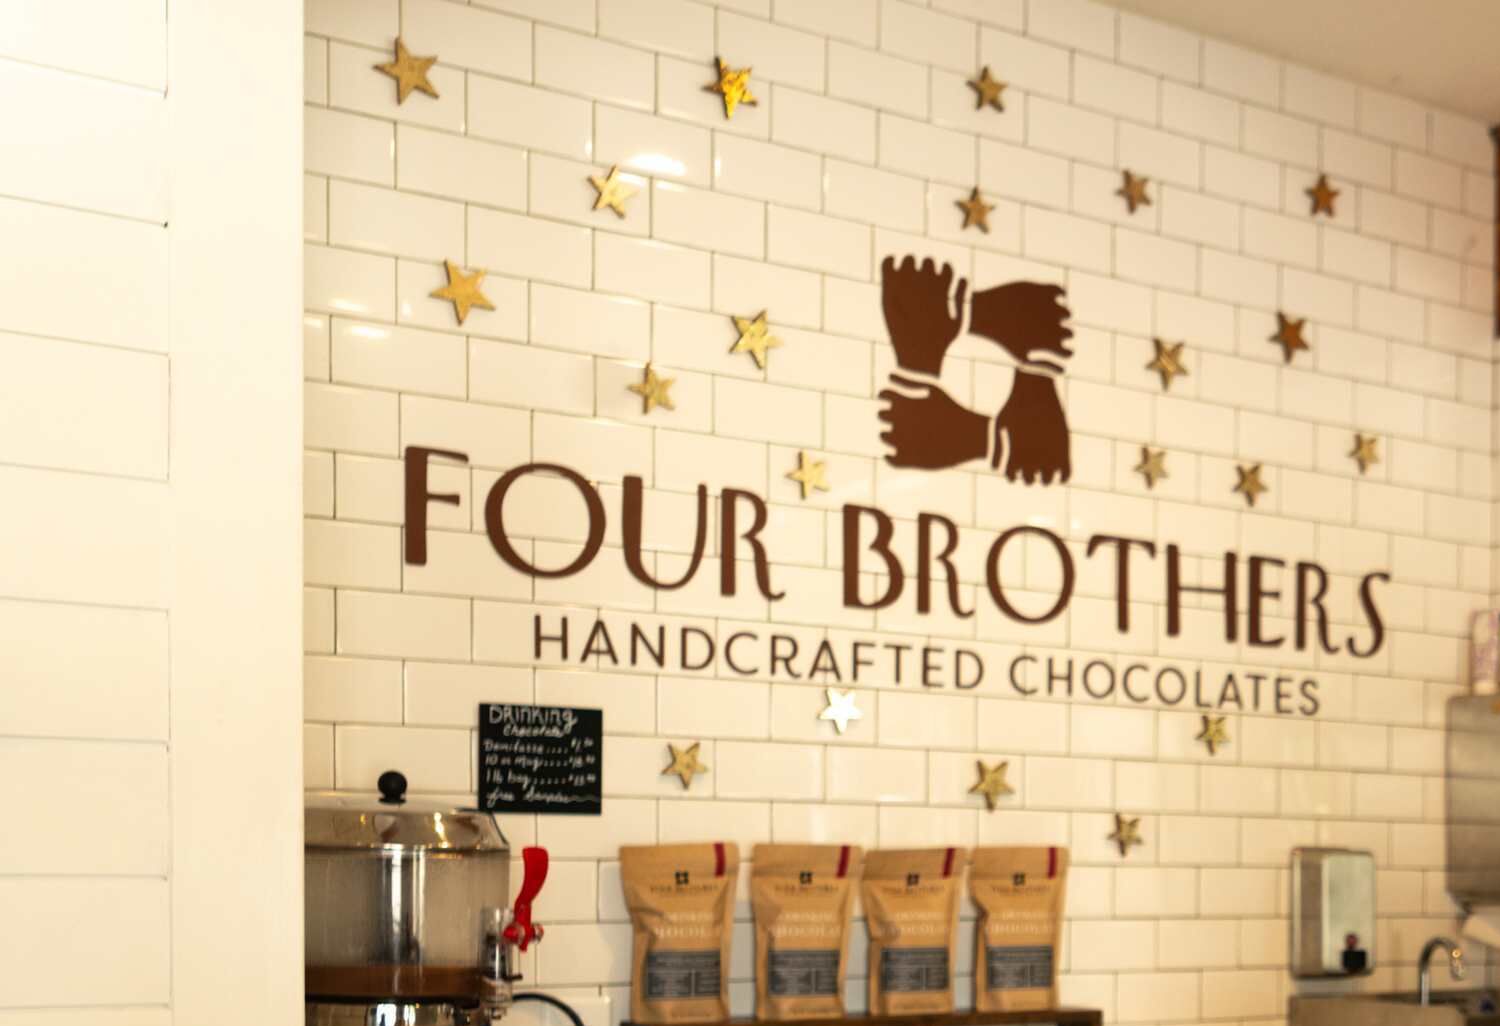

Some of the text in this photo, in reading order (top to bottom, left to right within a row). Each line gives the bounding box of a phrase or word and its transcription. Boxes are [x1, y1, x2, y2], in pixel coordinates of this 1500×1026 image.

[403, 445, 1391, 658] FOUR BROTHERS
[533, 614, 1321, 717] HANDCRAFTED CHOCOLATES
